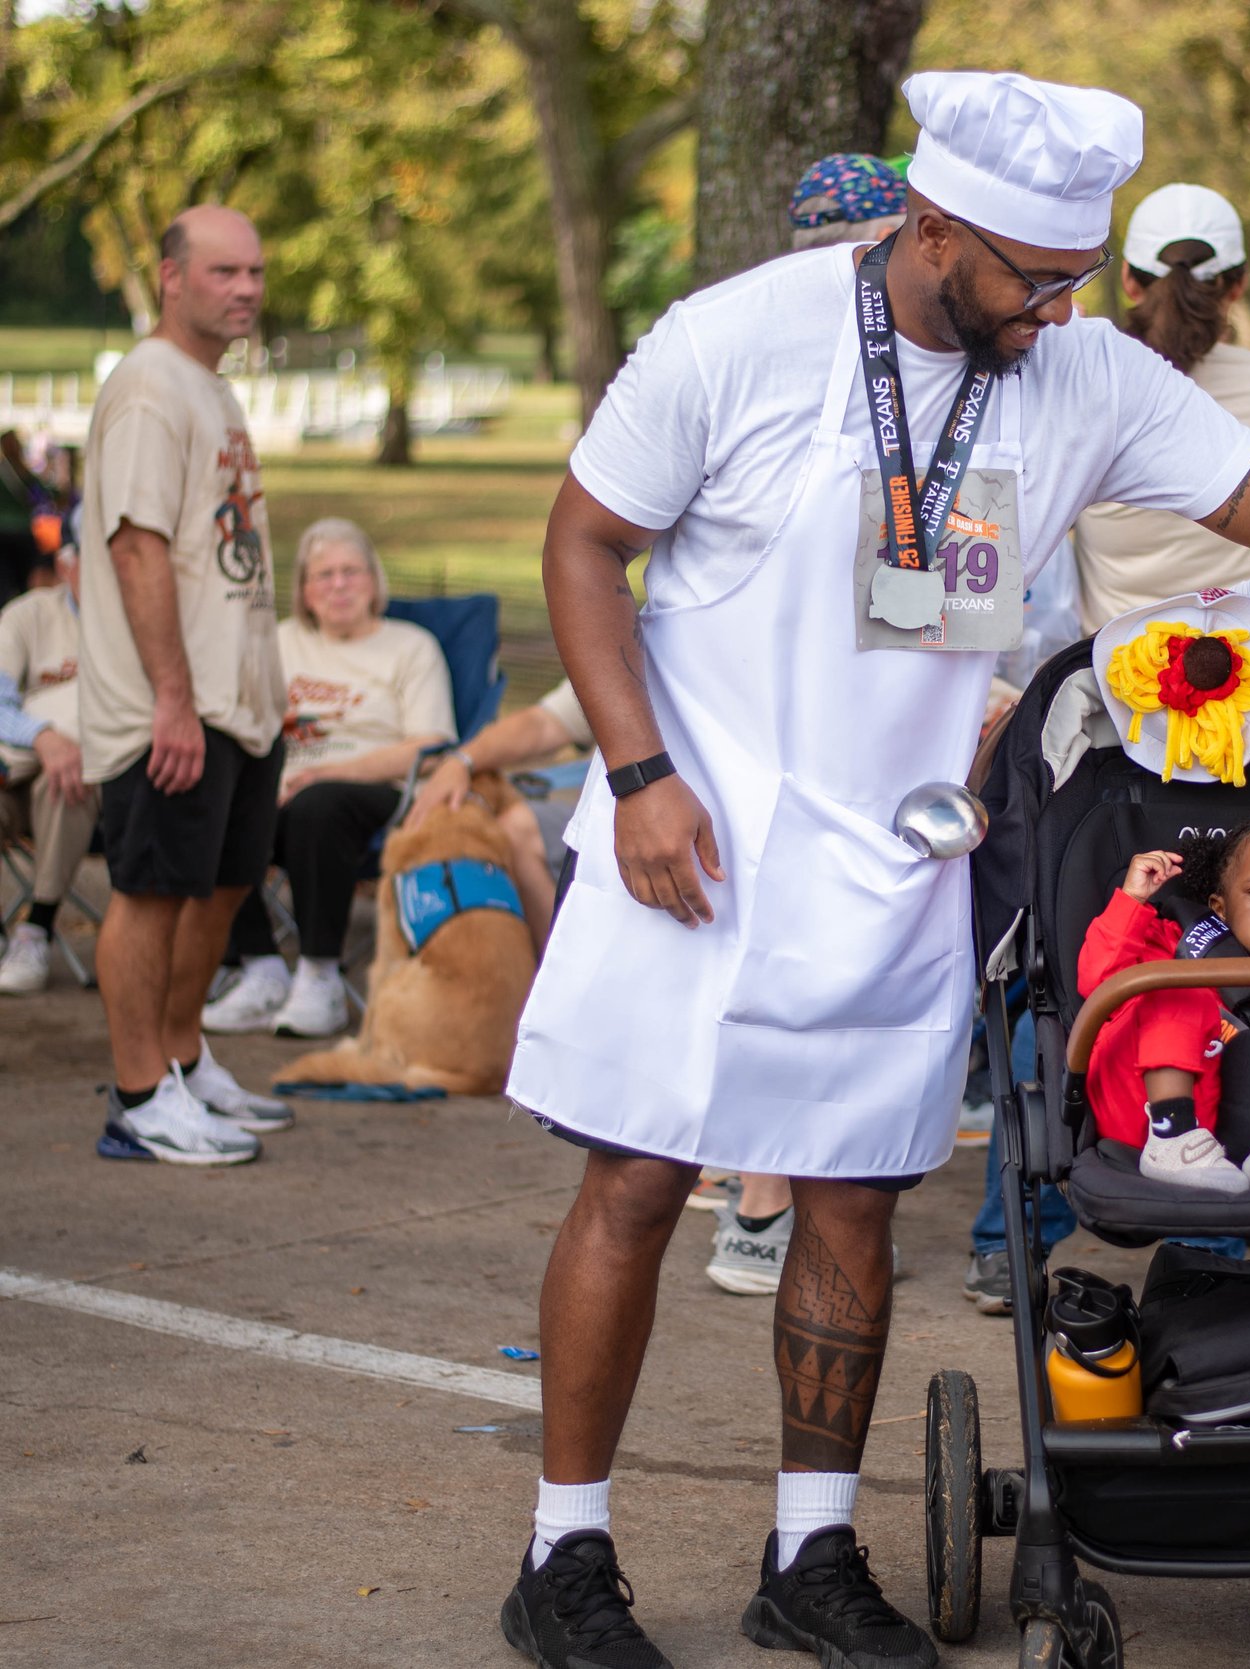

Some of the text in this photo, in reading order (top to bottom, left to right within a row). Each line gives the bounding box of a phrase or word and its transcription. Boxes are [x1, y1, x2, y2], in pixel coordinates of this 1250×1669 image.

[861, 280, 876, 334] TRINITY
[873, 291, 888, 332] FALLS
[873, 376, 900, 458] TEXANS
[953, 370, 991, 444] TEXANS
[920, 480, 941, 521] FALLS
[925, 486, 952, 538] TRINITY
[889, 475, 920, 569] 25 FINISHER
[974, 524, 983, 533] 5K
[945, 598, 995, 611] TEXANS
[1186, 920, 1212, 944] FALLS
[1190, 927, 1222, 958] TRINITY
[724, 1236, 777, 1262] HOKA
